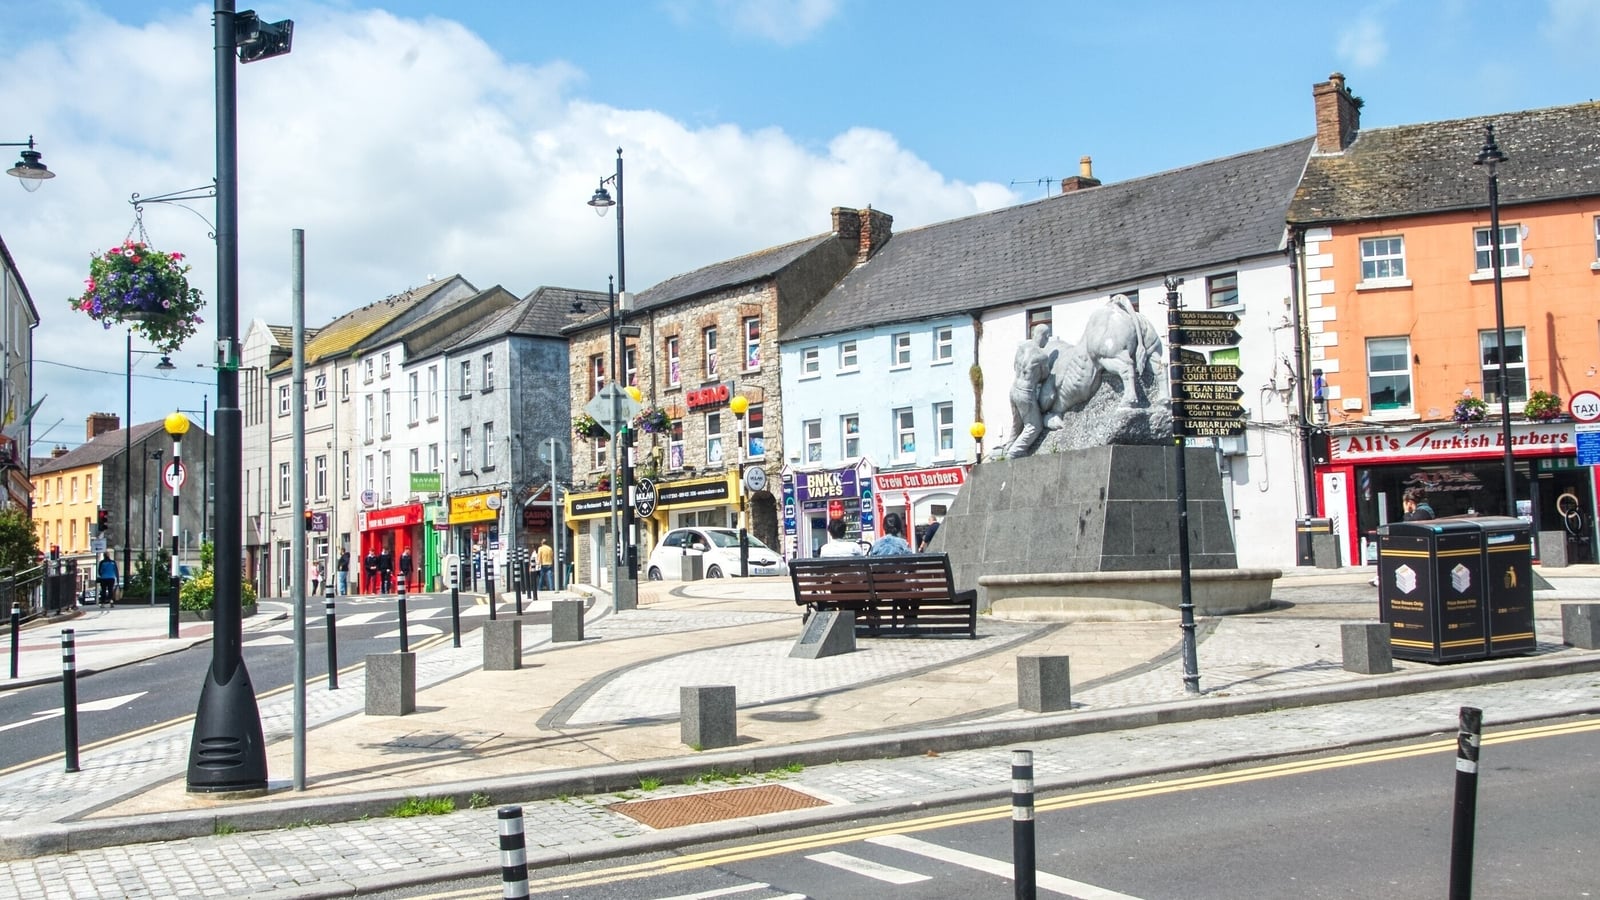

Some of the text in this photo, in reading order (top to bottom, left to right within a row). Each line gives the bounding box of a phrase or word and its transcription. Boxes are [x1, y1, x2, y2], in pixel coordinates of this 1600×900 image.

[687, 384, 729, 407] CASINO
[1574, 403, 1598, 414] TAXI
[1347, 429, 1568, 452] Ali's Turkish Barbers
[879, 476, 902, 489] Crew
[903, 474, 920, 486] Cut
[921, 472, 958, 485] Barbers
[808, 486, 843, 498] VAPES
